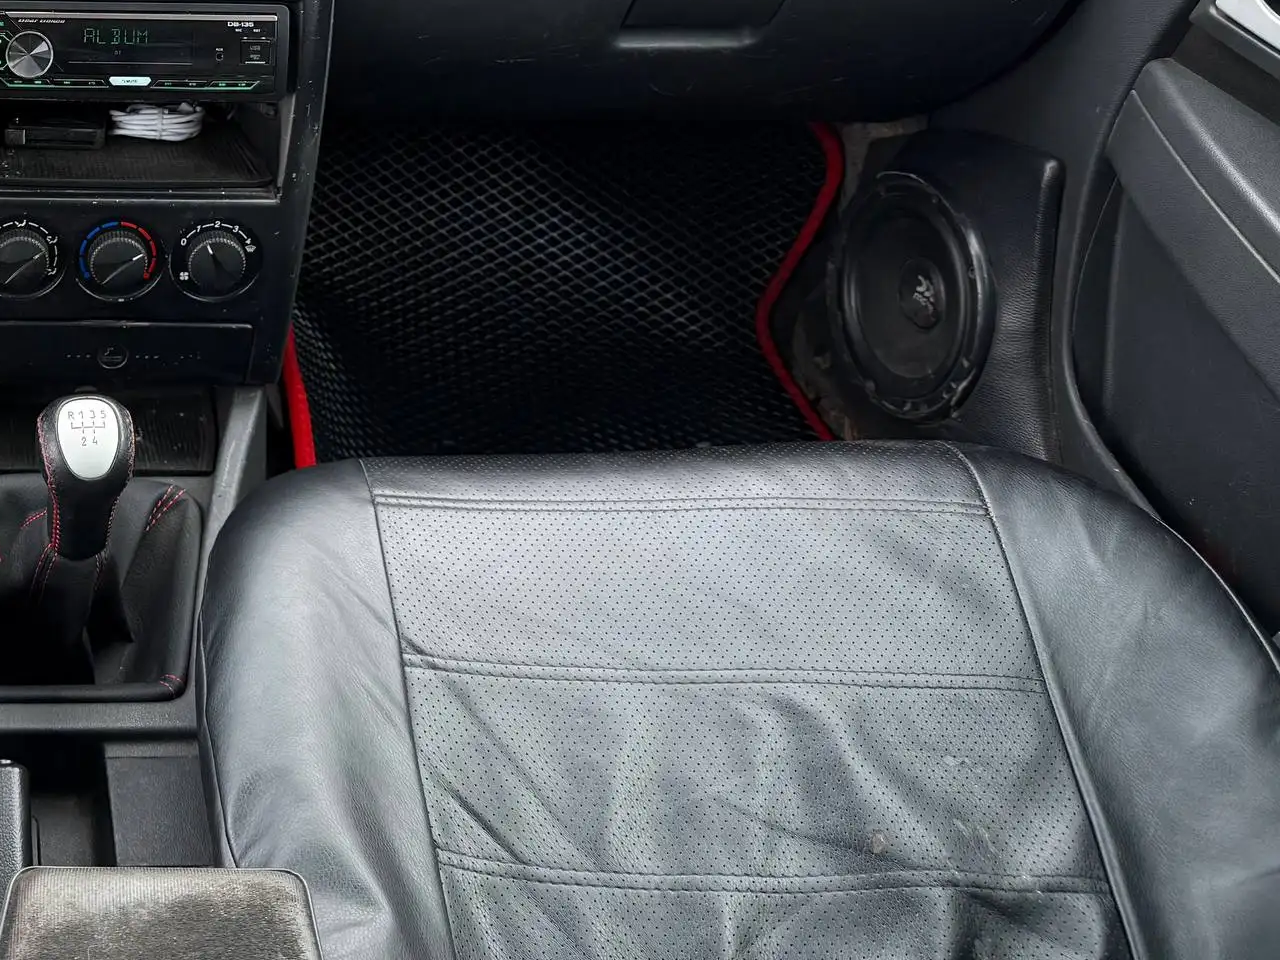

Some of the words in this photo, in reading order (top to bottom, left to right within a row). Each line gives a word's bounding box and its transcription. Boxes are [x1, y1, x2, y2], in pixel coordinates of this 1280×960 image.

[83, 28, 148, 45] ALBUM
[196, 224, 202, 233] 1
[214, 220, 221, 228] 2
[232, 225, 240, 233] 3
[180, 237, 188, 246] 0
[68, 411, 75, 420] R
[100, 410, 107, 419] 5
[81, 436, 88, 447] 2
[92, 436, 99, 446] 4
